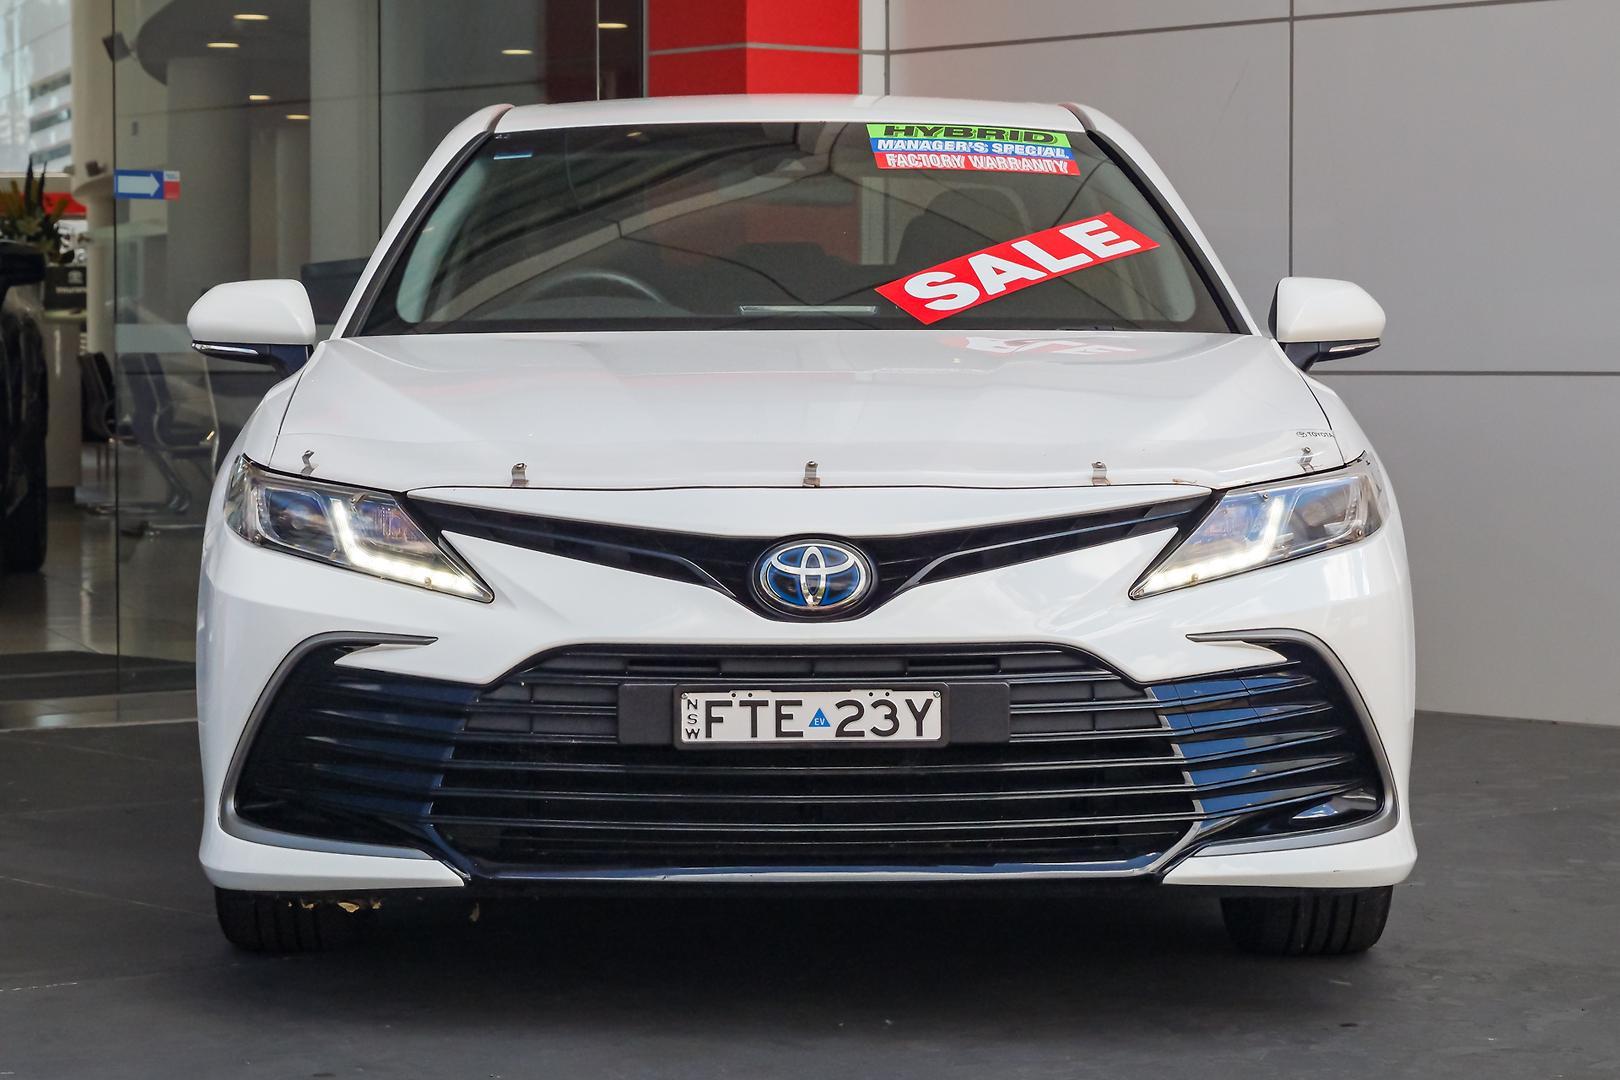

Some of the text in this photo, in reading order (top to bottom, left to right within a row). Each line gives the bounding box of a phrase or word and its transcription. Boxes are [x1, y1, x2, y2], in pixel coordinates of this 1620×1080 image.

[884, 125, 1056, 143] HYBRID
[877, 139, 1068, 159] MANAGER'S SPECIAL
[885, 153, 1069, 174] FACTORY WARRANTY
[904, 219, 1141, 311] SALE
[705, 699, 934, 739] FTE 23Y
[814, 718, 826, 726] EV
